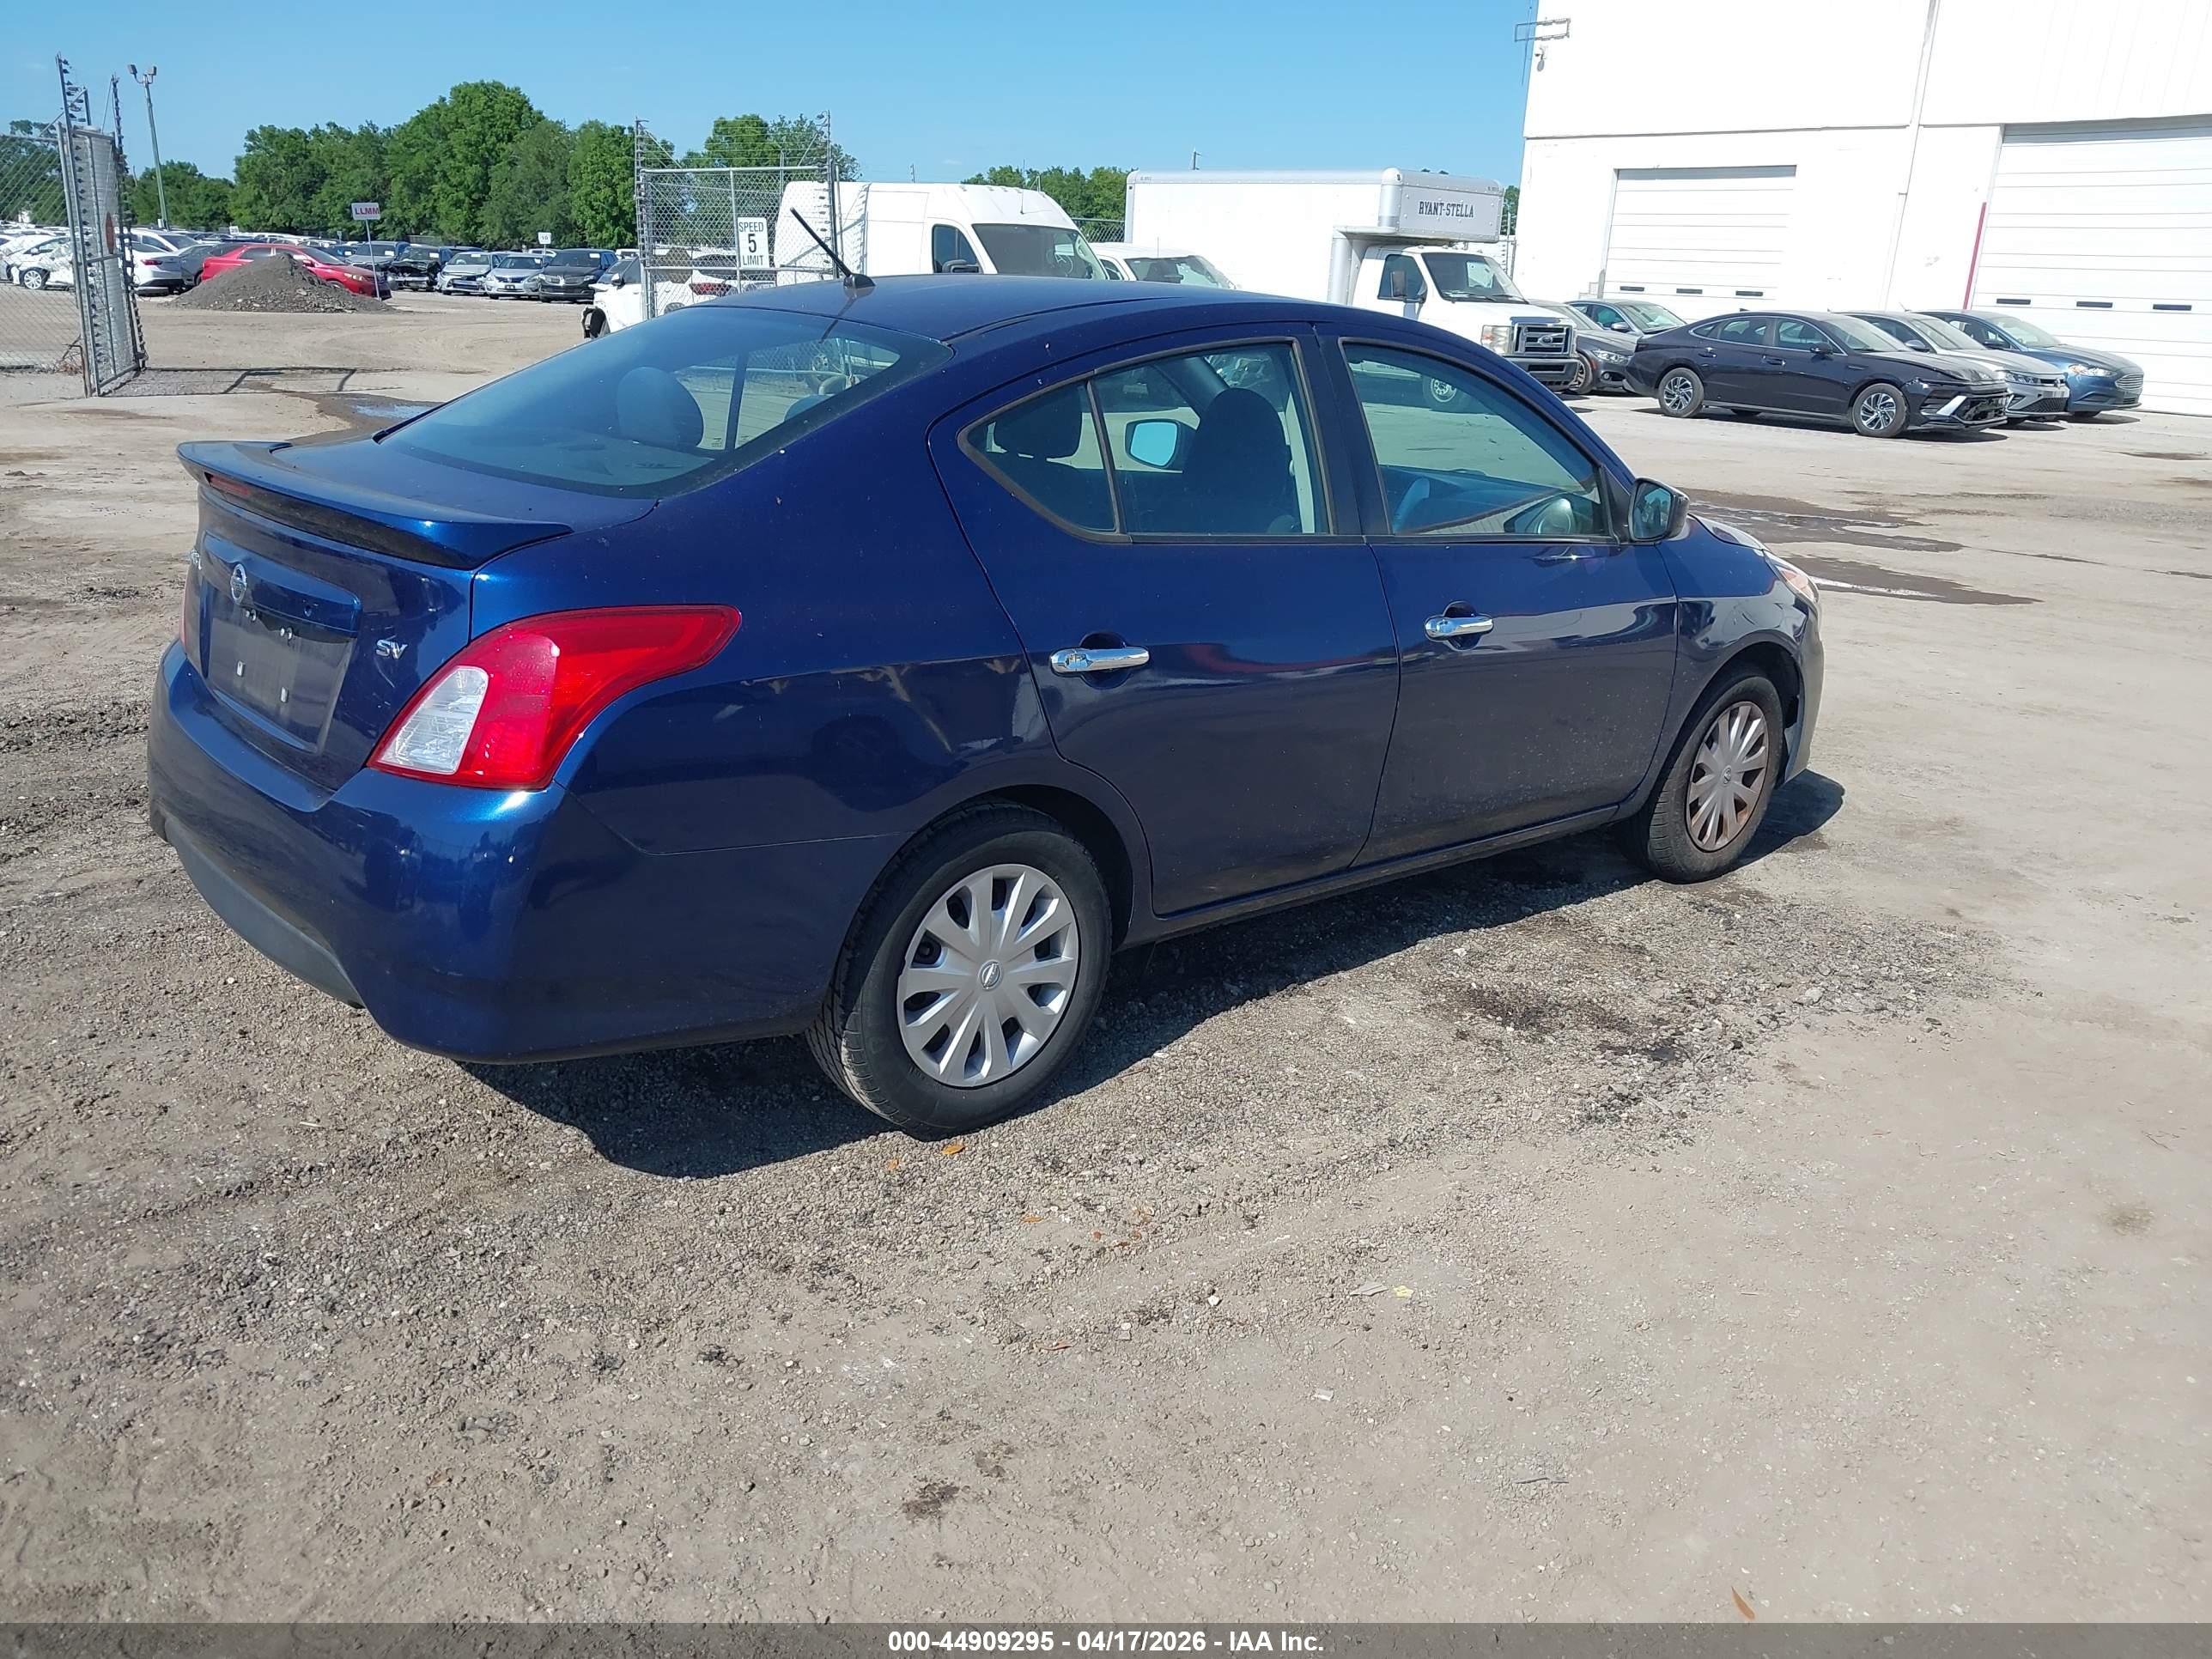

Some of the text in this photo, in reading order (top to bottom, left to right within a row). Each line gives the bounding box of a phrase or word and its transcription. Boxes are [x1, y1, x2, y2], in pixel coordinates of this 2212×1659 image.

[738, 222, 764, 233] SPEED
[748, 233, 757, 253] 5
[742, 255, 764, 266] LIMIT
[375, 639, 409, 660] SV
